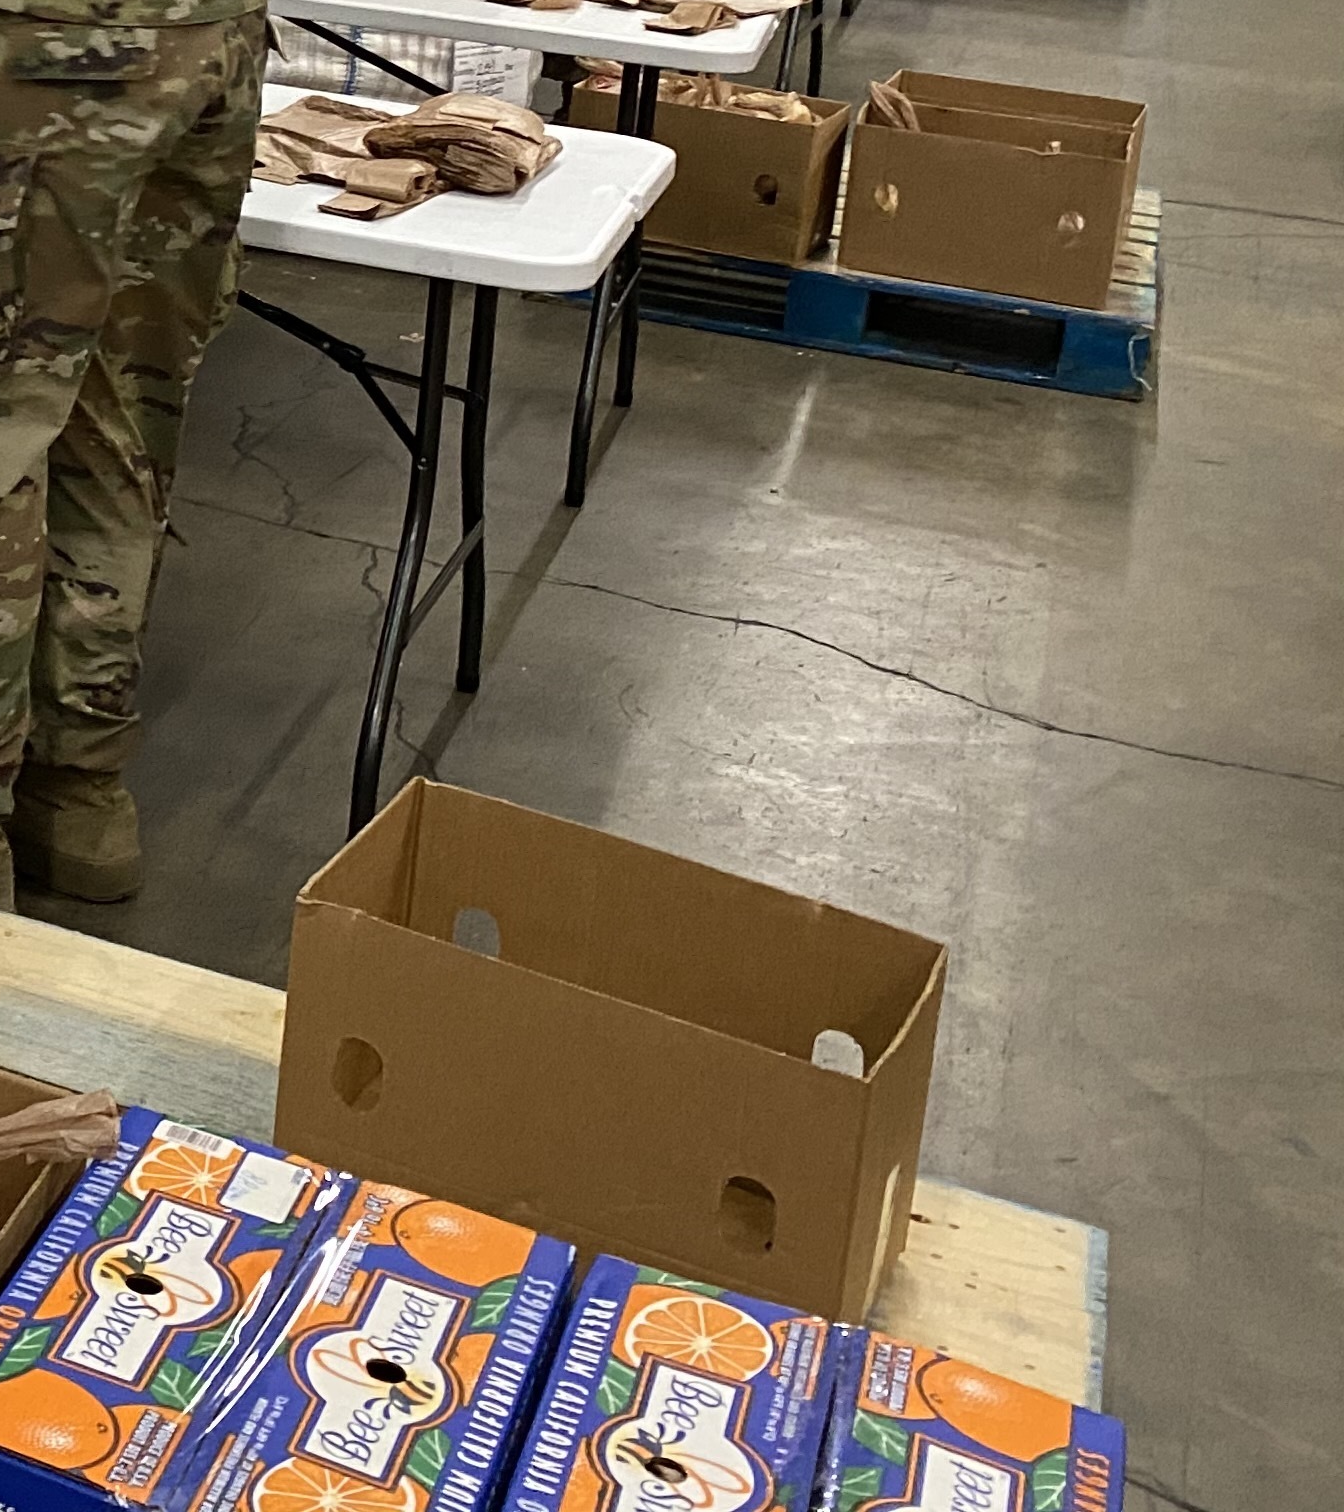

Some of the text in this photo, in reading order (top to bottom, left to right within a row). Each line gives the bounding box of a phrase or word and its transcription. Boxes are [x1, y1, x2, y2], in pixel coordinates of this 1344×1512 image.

[72, 1141, 141, 1208] PREMIUM
[7, 1207, 95, 1303] CALIFORNIA
[152, 1207, 216, 1255] Bee
[79, 1291, 162, 1370] Sweet
[368, 1289, 440, 1366] Sweet
[456, 1355, 527, 1469] CALIFORNIA
[501, 1275, 557, 1355] ORANGES
[522, 1296, 618, 1496] PREMIUM CALIFORNIA
[662, 1374, 728, 1431] Bee
[320, 1409, 387, 1467] Bee
[949, 1458, 996, 1512] eet
[1074, 1447, 1111, 1512] NGES
